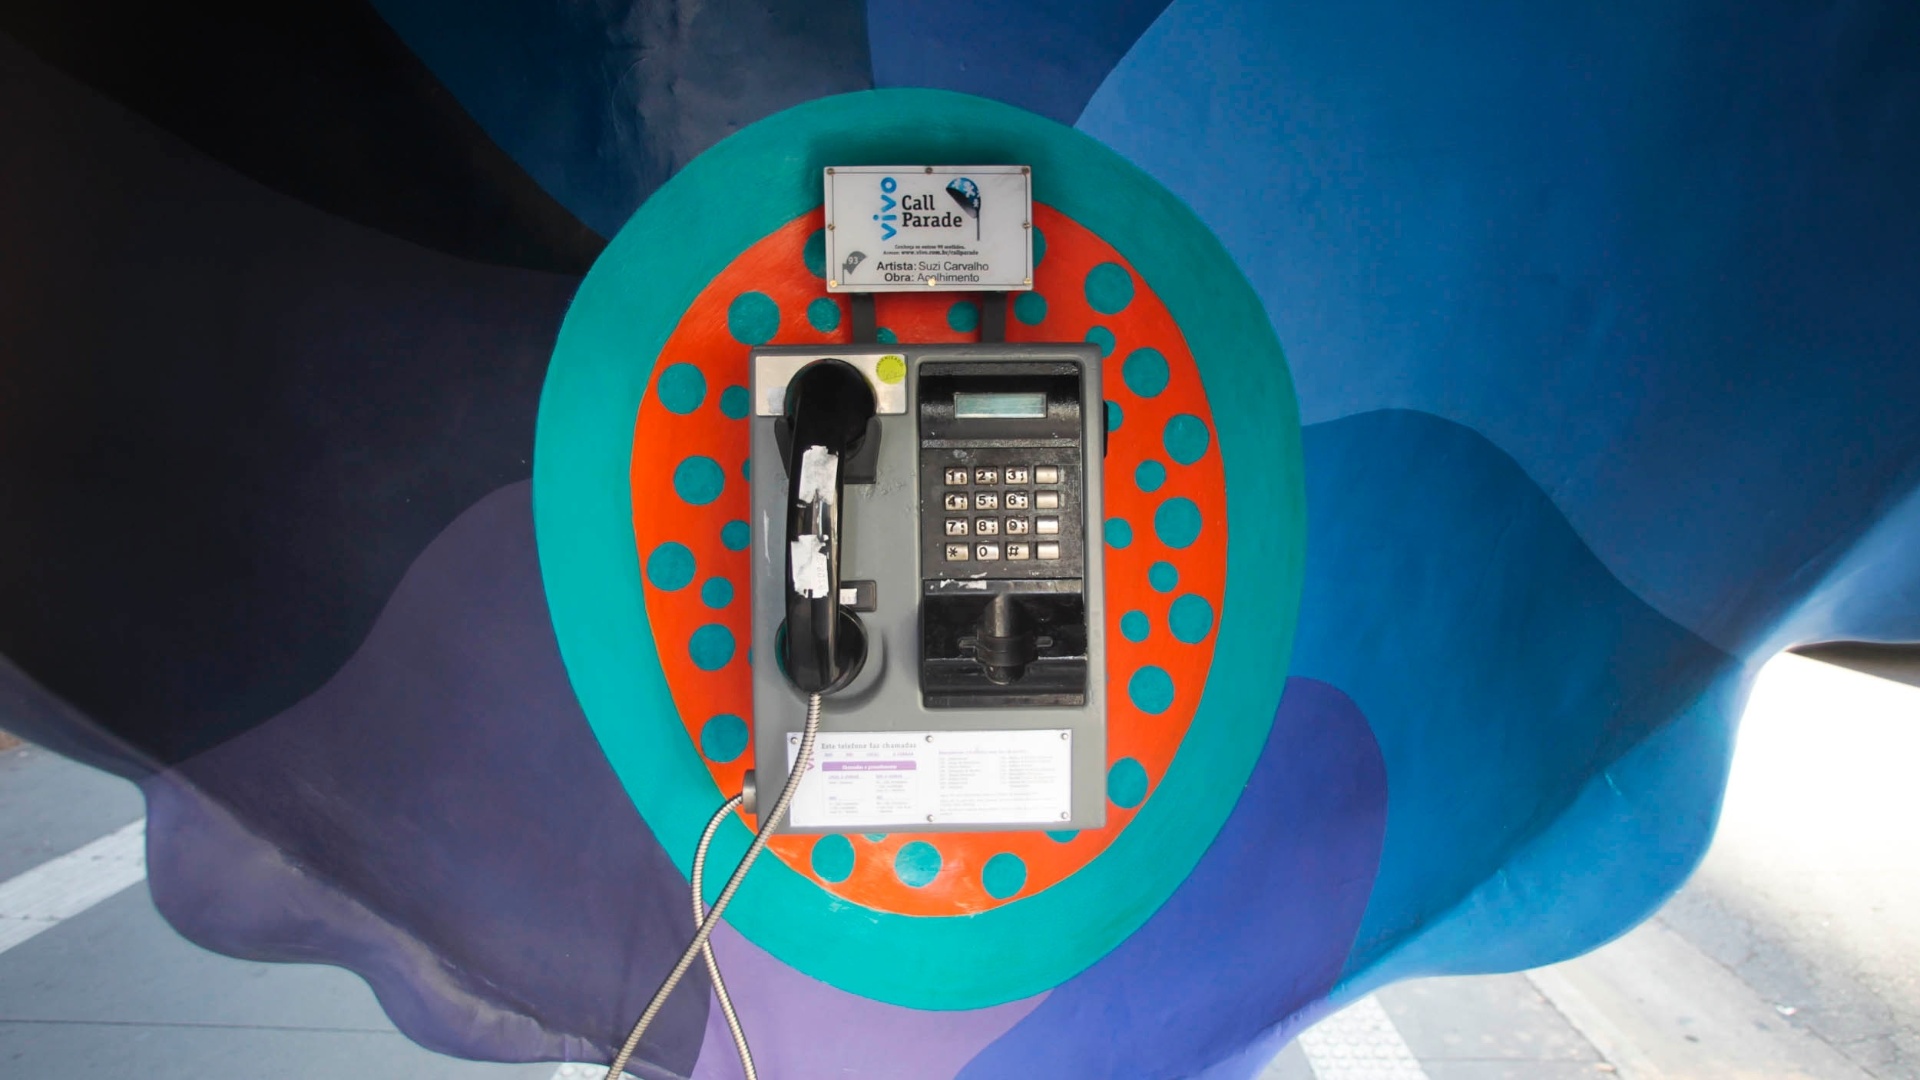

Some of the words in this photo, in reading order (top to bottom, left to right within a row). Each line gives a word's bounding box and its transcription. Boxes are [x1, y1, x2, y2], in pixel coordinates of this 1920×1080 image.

[902, 195, 935, 210] Call
[873, 177, 897, 241] vivo
[902, 212, 962, 228] Parade
[876, 262, 916, 271] Artista:
[919, 262, 940, 271] Suzi
[944, 261, 989, 271] Carvalho
[884, 273, 914, 282] Obra:
[948, 471, 955, 481] 1
[978, 471, 985, 481] 2
[1008, 471, 1016, 480] 3
[948, 496, 956, 506] 4
[978, 496, 986, 505] 5
[1008, 495, 1017, 505] 6
[948, 522, 956, 532] 7
[979, 521, 987, 531] 8
[1008, 521, 1018, 531] 9
